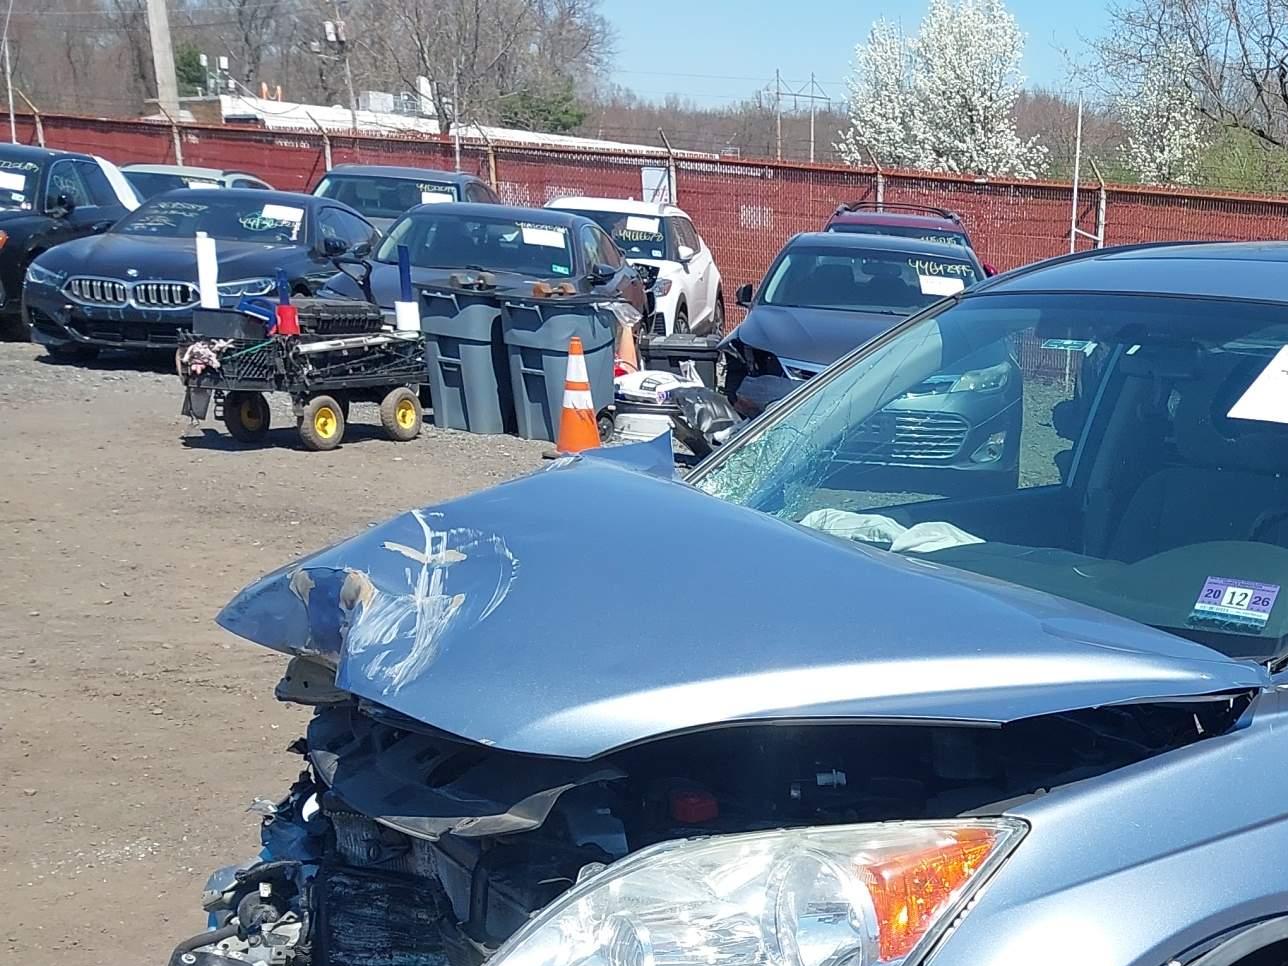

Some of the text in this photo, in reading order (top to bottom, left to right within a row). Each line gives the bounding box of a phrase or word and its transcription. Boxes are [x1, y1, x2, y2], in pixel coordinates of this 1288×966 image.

[1204, 588, 1271, 607] 20 12 26
